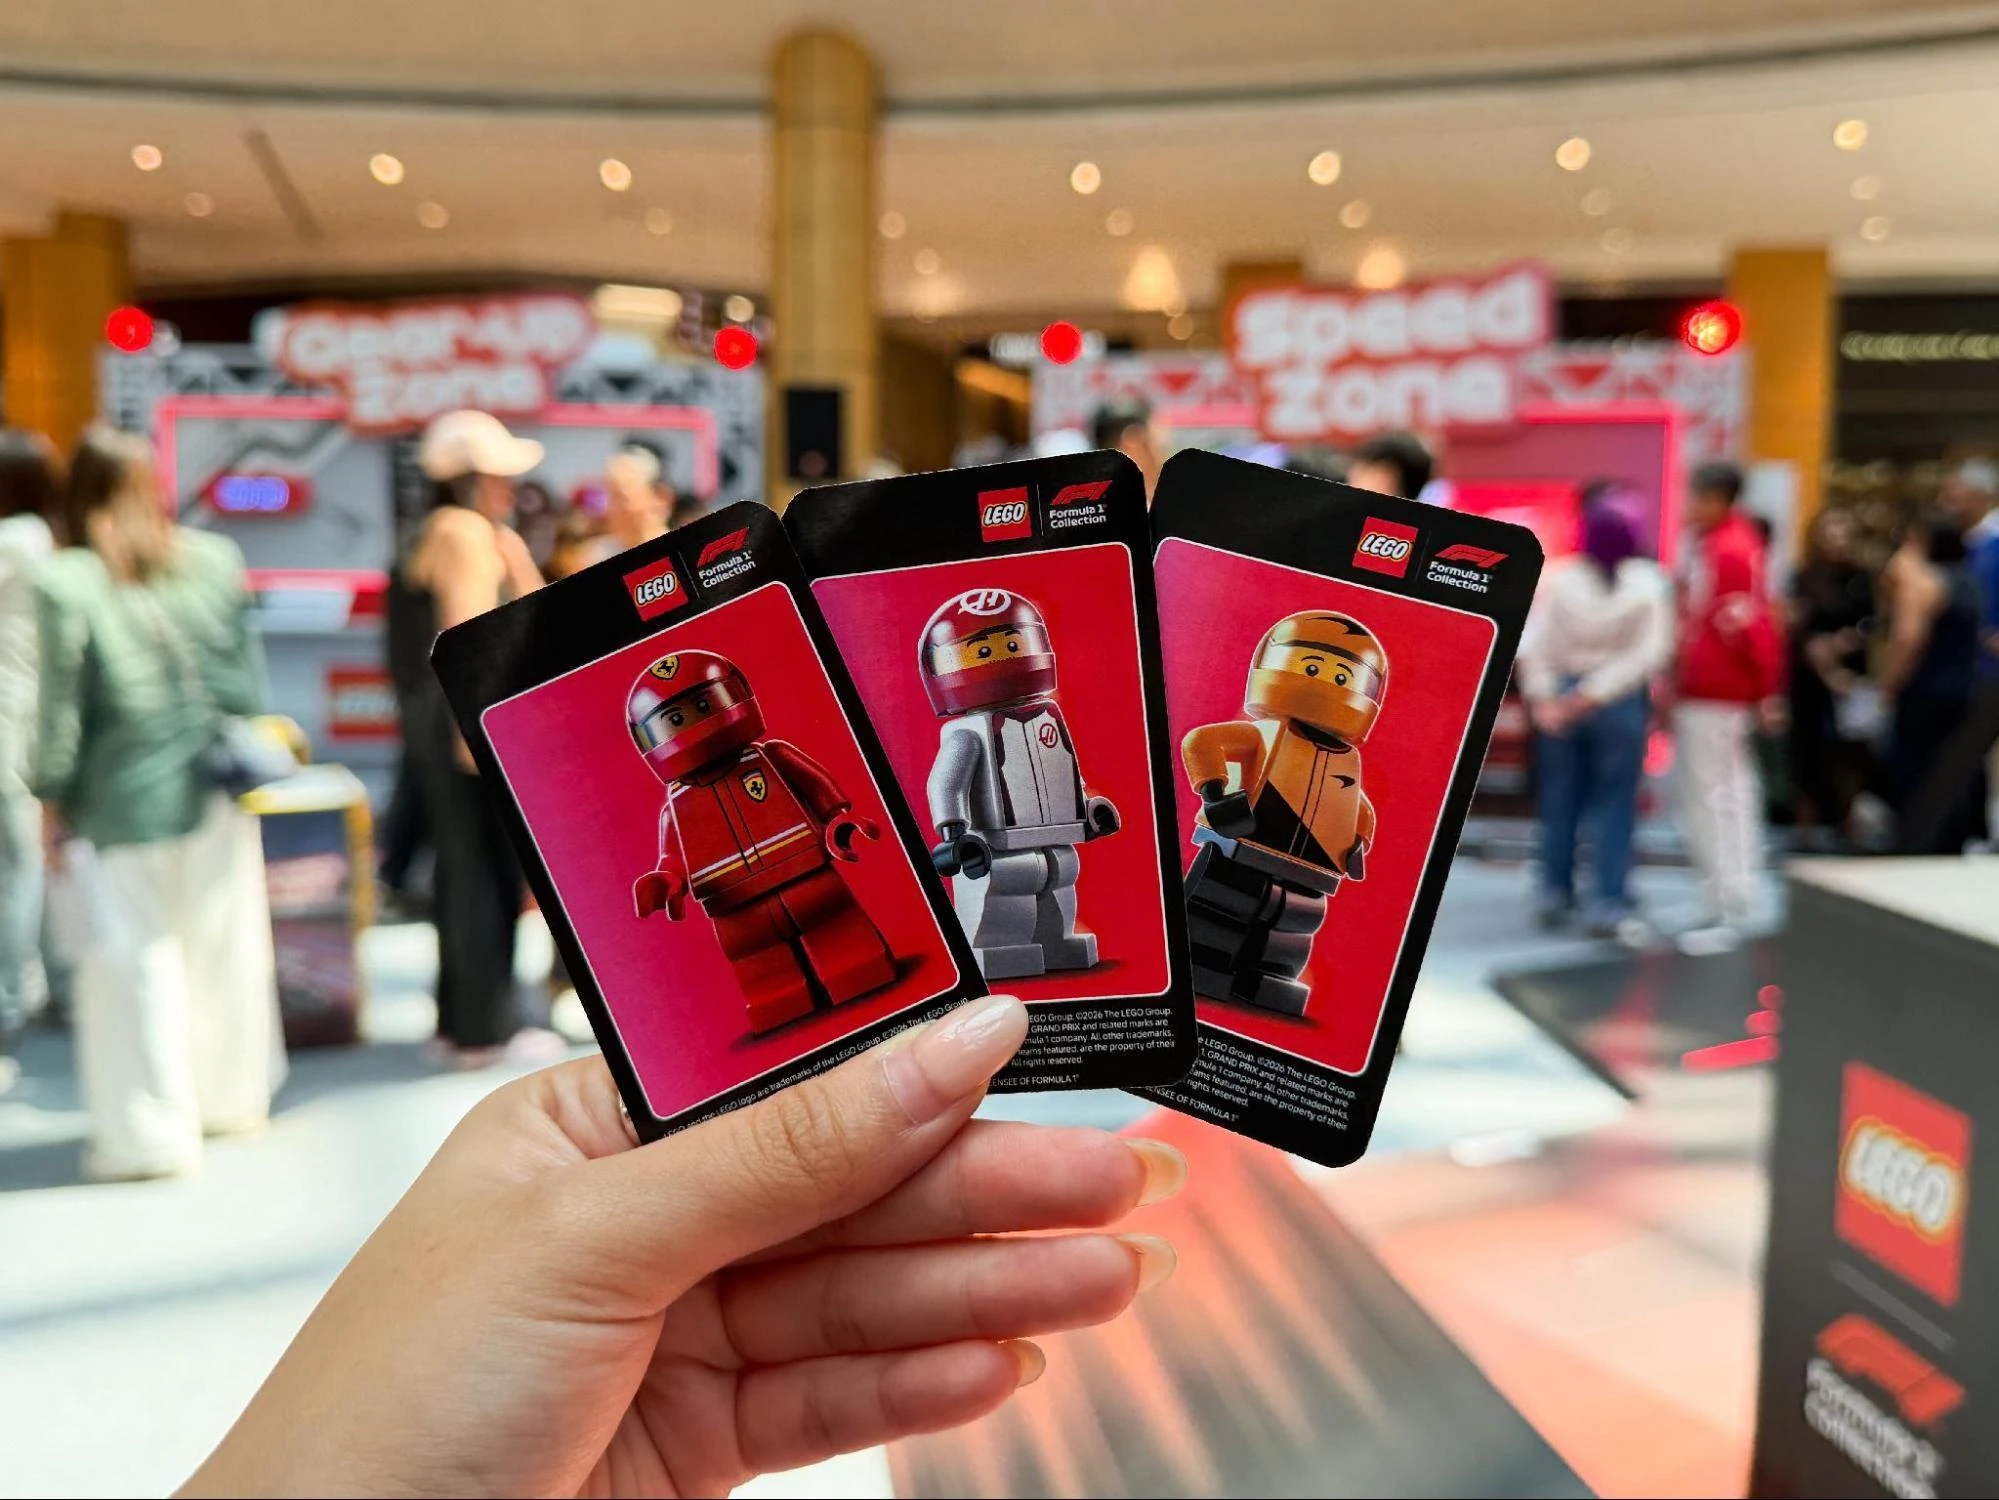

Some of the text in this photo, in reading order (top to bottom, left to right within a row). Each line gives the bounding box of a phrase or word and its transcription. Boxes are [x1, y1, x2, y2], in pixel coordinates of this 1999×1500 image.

[983, 502, 1026, 526] LEGO
[1049, 506, 1096, 519] Formula
[1050, 515, 1107, 529] Collection
[1360, 533, 1410, 560] LEGO
[698, 555, 743, 580] Formula
[702, 560, 757, 589] Collection
[1429, 561, 1480, 580] Formula
[635, 573, 676, 605] LEGO
[1426, 572, 1488, 593] Collection
[1028, 1013, 1046, 1023] EGO
[1047, 1013, 1074, 1022] Group.
[1120, 1008, 1144, 1017] LEGO
[1144, 1008, 1172, 1017] Group.
[1030, 1018, 1169, 1033] GRAND PRIX and related marks are
[1093, 1043, 1108, 1051] the
[1109, 1042, 1144, 1052] property
[1146, 1040, 1155, 1049] of
[1156, 1039, 1175, 1048] their
[1102, 1031, 1124, 1040] other
[737, 1093, 756, 1105] logo
[770, 1069, 812, 1090] trademarks
[812, 1061, 821, 1071] of
[821, 1057, 834, 1067] the
[835, 1046, 856, 1061] LEGO
[924, 1007, 944, 1020] LEGO
[1022, 1058, 1045, 1067] rights
[1047, 1055, 1083, 1064] reserved.
[1205, 1038, 1227, 1052] LEGO
[1286, 1066, 1303, 1079] The
[1303, 1073, 1327, 1088] LEGO
[1019, 1076, 1029, 1085] OF
[1031, 1074, 1072, 1084] FORMULA
[1186, 1078, 1210, 1092] rights
[1197, 1059, 1216, 1071] mula
[1263, 1082, 1275, 1093] All
[1276, 1088, 1299, 1100] other
[1207, 1050, 1237, 1067] GRAND
[1238, 1060, 1259, 1074] PRIX
[1258, 1070, 1276, 1081] and
[1276, 1076, 1306, 1092] related
[1307, 1087, 1333, 1102] marks
[1334, 1099, 1349, 1107] are
[1176, 1094, 1189, 1103] OF
[1188, 1097, 1229, 1120] FORMULA
[1248, 1089, 1263, 1099] are
[1263, 1094, 1278, 1105] the
[1279, 1101, 1316, 1120] property
[1316, 1114, 1327, 1122] of
[1843, 1121, 1962, 1238] LEGO
